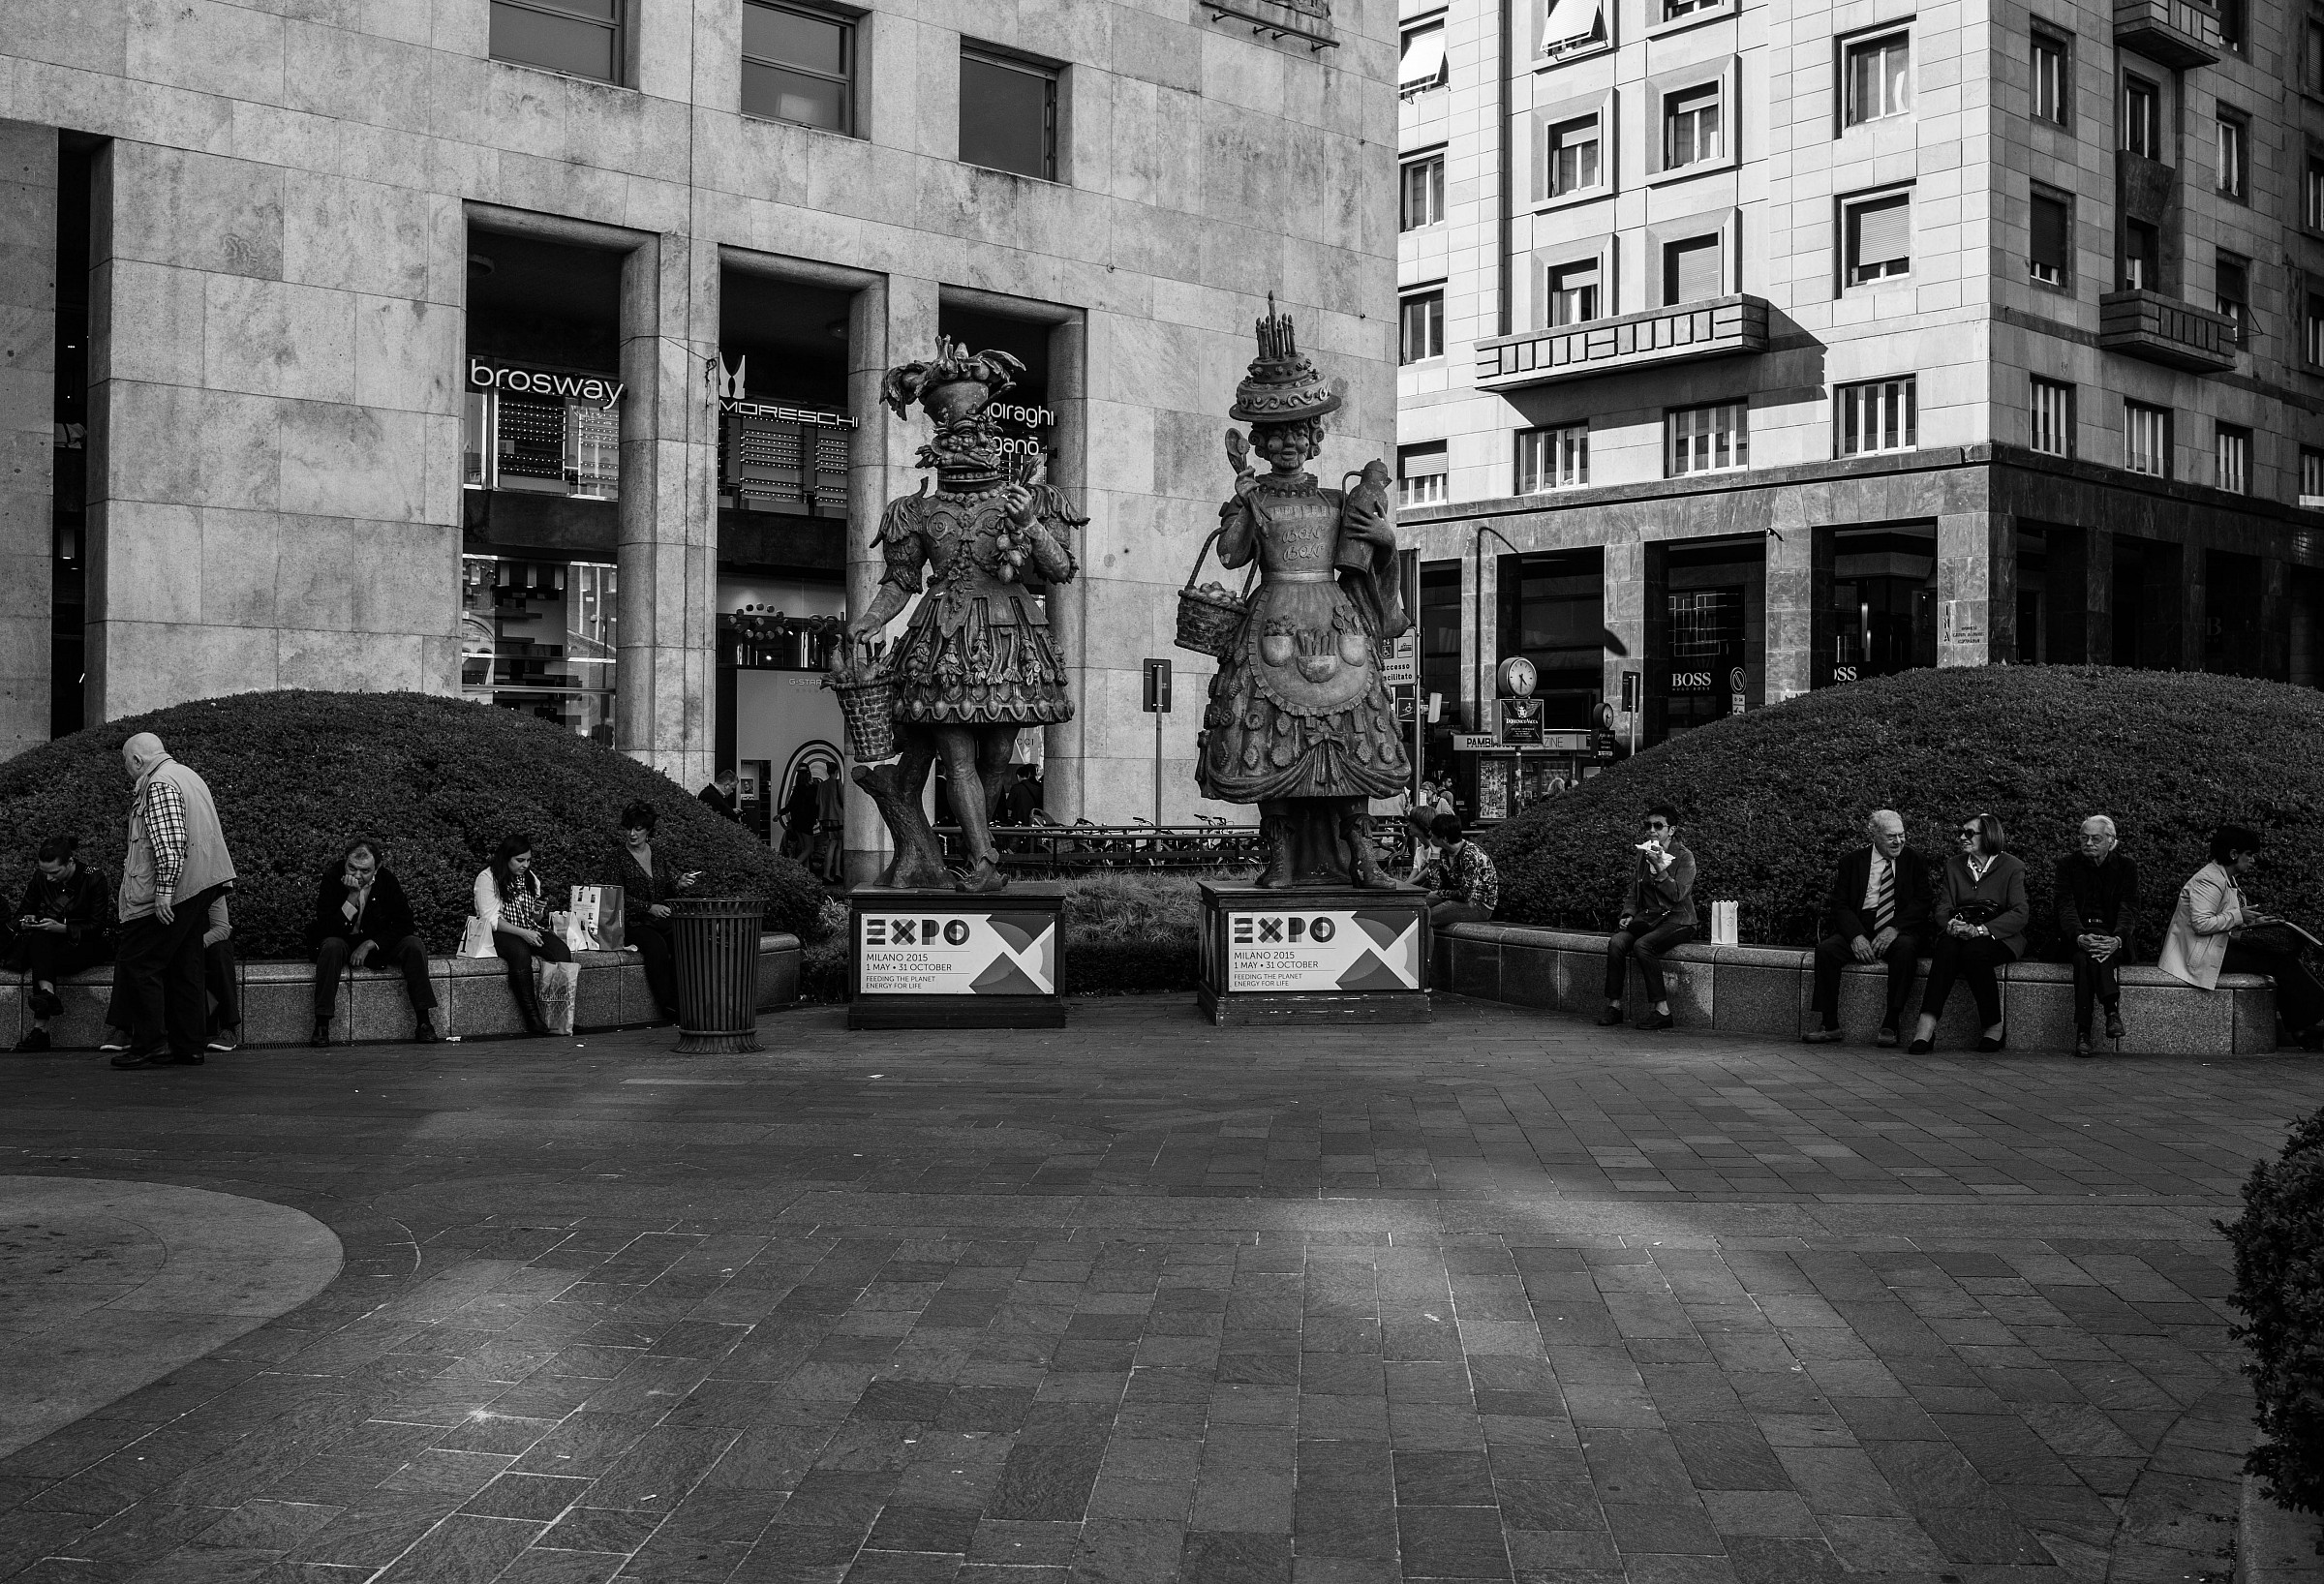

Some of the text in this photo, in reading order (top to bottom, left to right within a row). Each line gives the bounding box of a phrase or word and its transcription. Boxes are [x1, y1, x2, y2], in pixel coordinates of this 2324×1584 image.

[471, 358, 624, 410] brosway
[719, 399, 858, 428] MORESCHI
[985, 402, 1055, 429] oiraghi
[1384, 673, 1413, 682] cilitato
[1671, 672, 1712, 687] BOSS
[867, 918, 970, 946] EXPO
[1234, 916, 1336, 944] EXPO
[906, 953, 929, 961] 2015
[1273, 951, 1295, 960] 2015
[1277, 960, 1319, 969] OCTOBER
